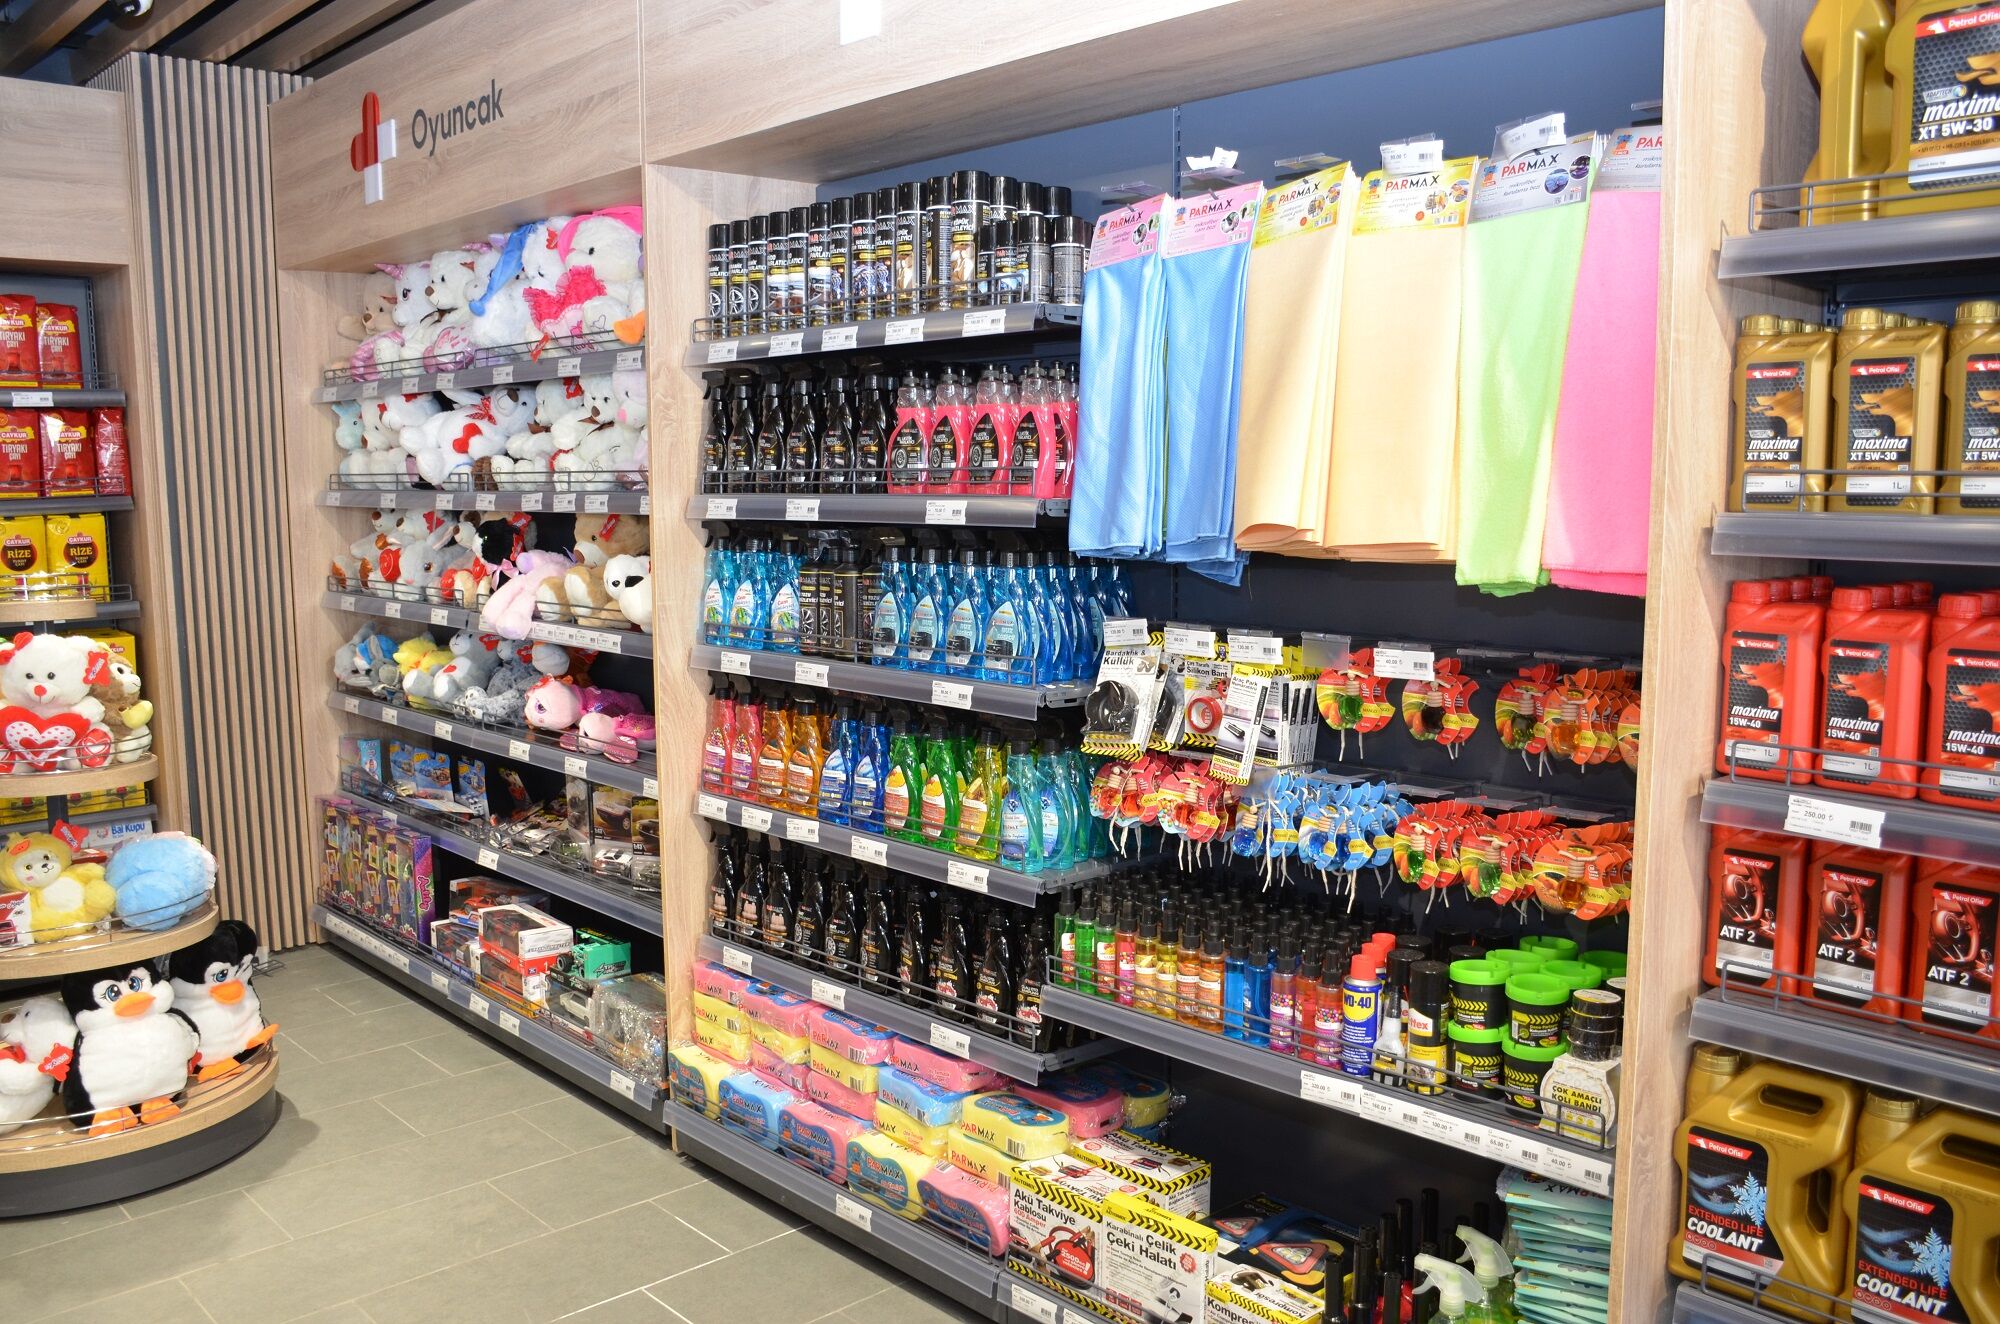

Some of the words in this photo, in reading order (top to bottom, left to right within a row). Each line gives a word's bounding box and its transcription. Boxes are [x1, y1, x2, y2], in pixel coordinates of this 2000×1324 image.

[1948, 16, 1976, 30] Petrol
[412, 79, 504, 156] Oyuncak
[1918, 125, 1938, 141] XT
[1942, 116, 1993, 137] 5W-30
[1502, 153, 1560, 178] PARMAX
[1385, 174, 1440, 192] PARMAX
[1279, 182, 1320, 204] PARMAX
[1189, 199, 1233, 218] PARMAX
[1109, 211, 1144, 230] PARMAX
[1749, 436, 1798, 450] maxima
[1852, 436, 1908, 450] maxima
[1747, 452, 1758, 461] XT
[1760, 452, 1789, 461] 5W-30
[1850, 452, 1864, 461] XT
[1864, 452, 1897, 461] 5W-30
[1965, 452, 1980, 461] XT
[1981, 452, 2000, 461] 5W-
[1746, 640, 1761, 648] Petrol
[1103, 656, 1135, 666] Küllük
[1846, 650, 1860, 658] Petrol
[1966, 658, 1984, 667] Petrol
[1984, 659, 1999, 668] Ofisi
[1186, 666, 1210, 676] Silikon
[1211, 669, 1228, 678] Bant
[1731, 705, 1778, 720] maxima
[1730, 716, 1761, 729] 15W-40
[1829, 716, 1880, 732] maxima
[1826, 728, 1860, 741] 15W-40
[1946, 742, 1984, 755] 15W-40
[1804, 811, 1826, 820] 250.00
[1740, 858, 1755, 868] Petrol
[1840, 874, 1856, 884] Petrol
[1952, 894, 1970, 904] Petrol
[1970, 896, 1985, 905] Ofisi
[1720, 924, 1744, 940] ATF
[1747, 930, 1755, 942] 2
[1818, 944, 1842, 959] ATF
[1846, 950, 1855, 962] 2
[1928, 966, 1955, 982] ATF
[1960, 973, 1969, 986] 2
[812, 1060, 841, 1078] PARMAX
[732, 1094, 764, 1114] PARMAX
[1552, 1084, 1569, 1097] ÇOK
[1570, 1090, 1603, 1106] AMAÇLI
[796, 1124, 831, 1146] PARMAX
[960, 1122, 996, 1142] PARMAX
[1132, 1141, 1168, 1158] Takviye
[1708, 1142, 1726, 1154] Petrol
[1728, 1147, 1744, 1158] Ofisi
[866, 1156, 901, 1180] PARMAX
[952, 1150, 988, 1174] PARMAX
[1014, 1188, 1034, 1205] Akü
[1036, 1199, 1076, 1226] Takviye
[1014, 1200, 1046, 1222] Kablosu
[1883, 1193, 1905, 1207] Petrol
[1906, 1199, 1924, 1212] Ofisi
[1026, 1214, 1046, 1228] Amper
[1688, 1206, 1739, 1230] EXTENDED
[1740, 1222, 1764, 1238] LIFE
[1106, 1221, 1144, 1242] Karabinalı
[1146, 1234, 1176, 1256] Çelik
[1687, 1216, 1763, 1252] COOLANT
[1107, 1232, 1135, 1252] Çeki
[1140, 1245, 1176, 1270] Halatı
[1858, 1261, 1918, 1290] EXTENDED
[1920, 1282, 1948, 1300] LIFE
[1856, 1272, 1948, 1316] COOLANT
